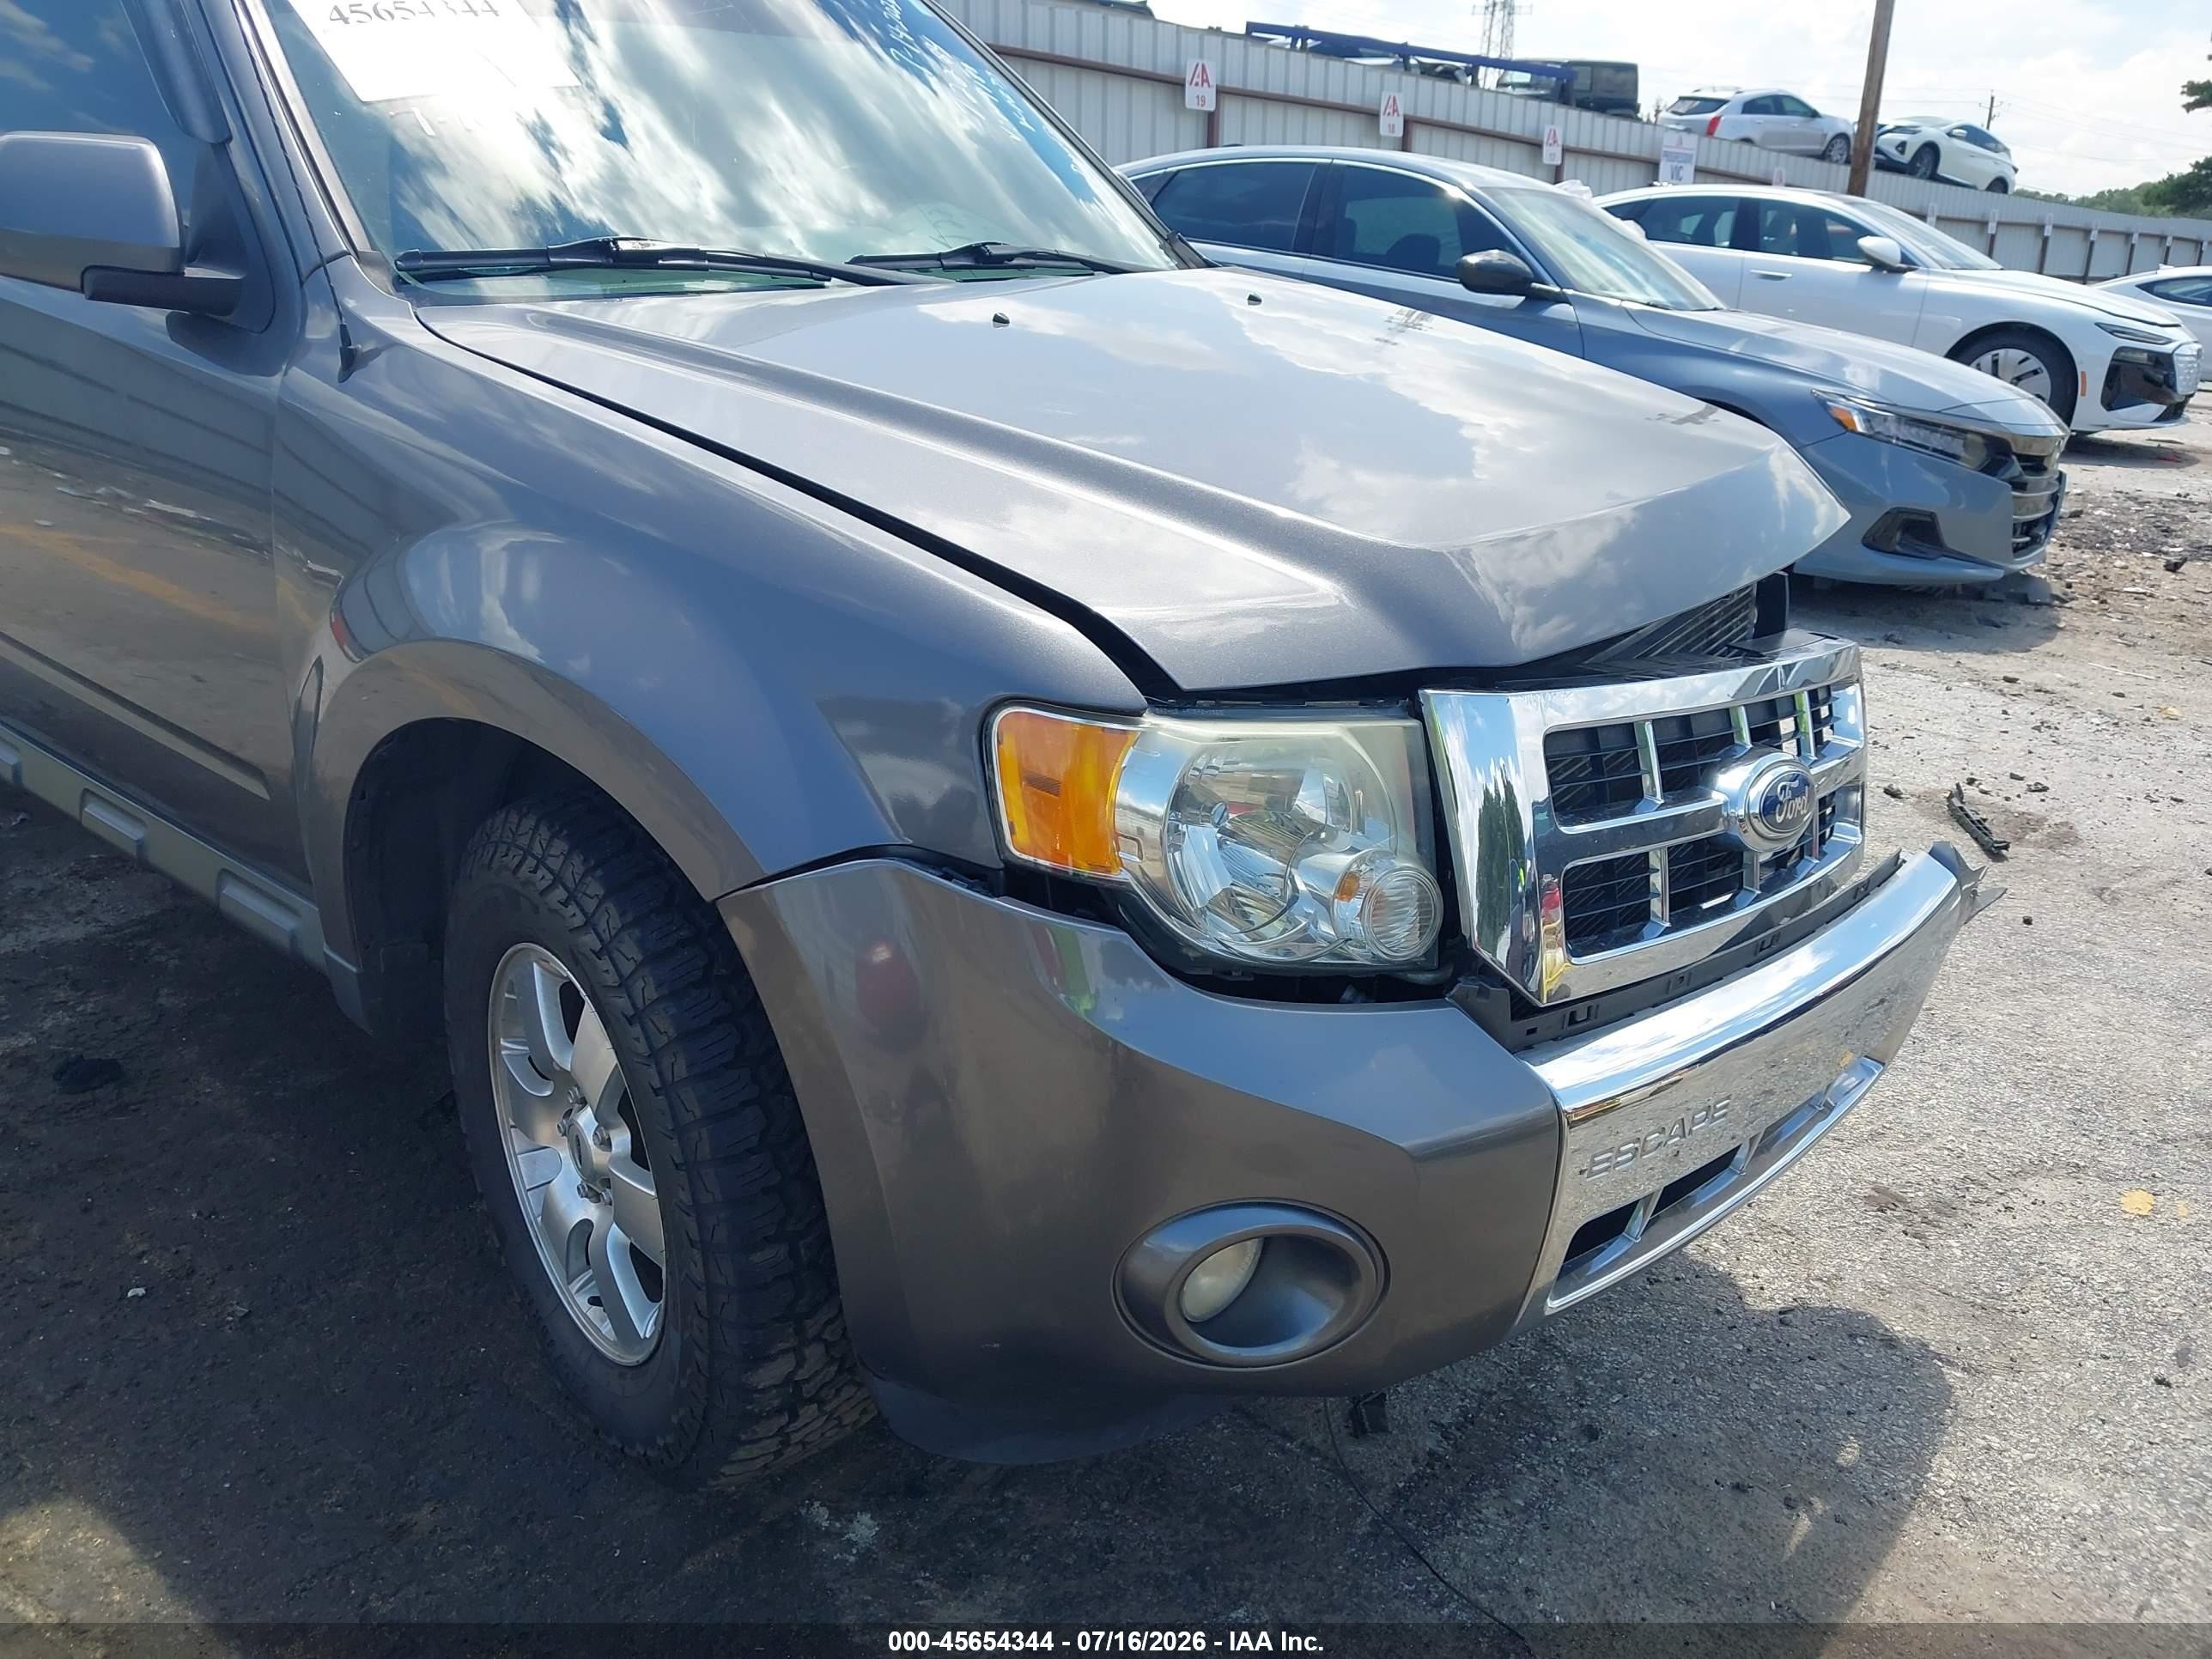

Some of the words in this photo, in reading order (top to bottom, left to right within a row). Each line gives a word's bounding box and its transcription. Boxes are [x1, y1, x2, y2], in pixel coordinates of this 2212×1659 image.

[1196, 94, 1206, 107] 19
[1776, 780, 1809, 823] Ford
[1587, 1094, 1732, 1182] ESCAPE
